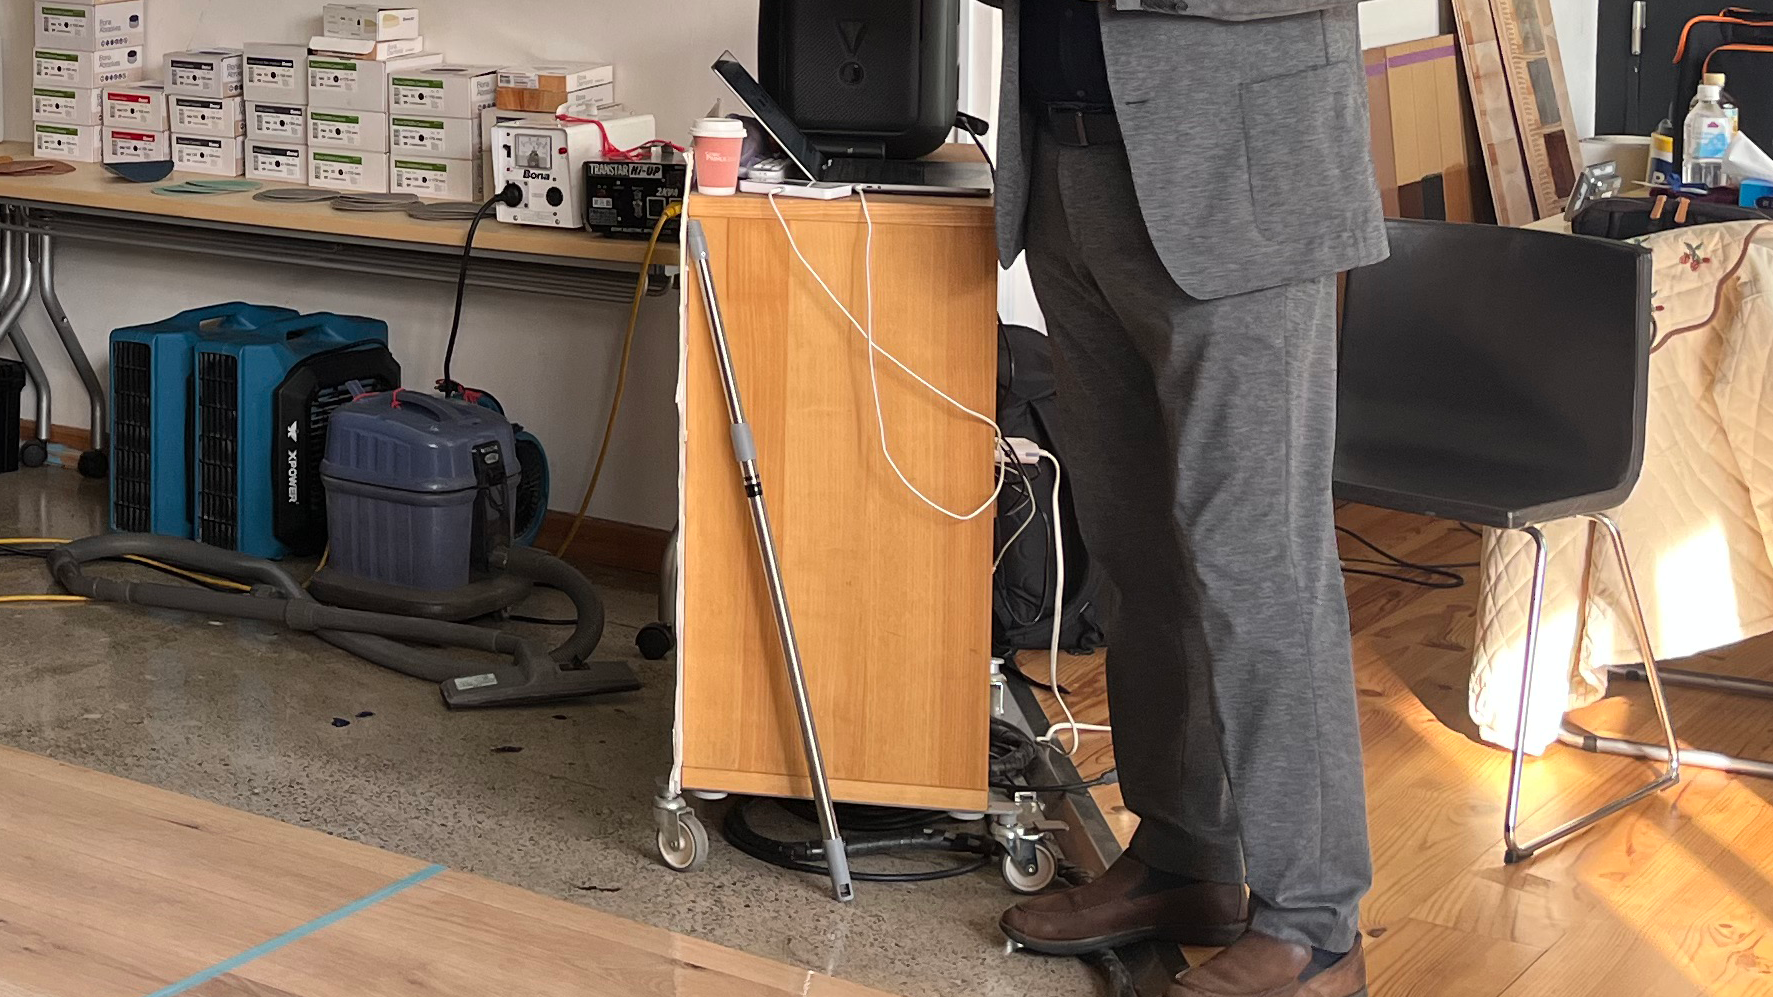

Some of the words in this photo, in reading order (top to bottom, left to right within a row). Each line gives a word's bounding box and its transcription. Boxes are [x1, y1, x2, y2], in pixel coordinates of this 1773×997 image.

[523, 169, 550, 180] Bona
[589, 163, 628, 176] TRANSTAR
[288, 449, 298, 503] XPOWER
